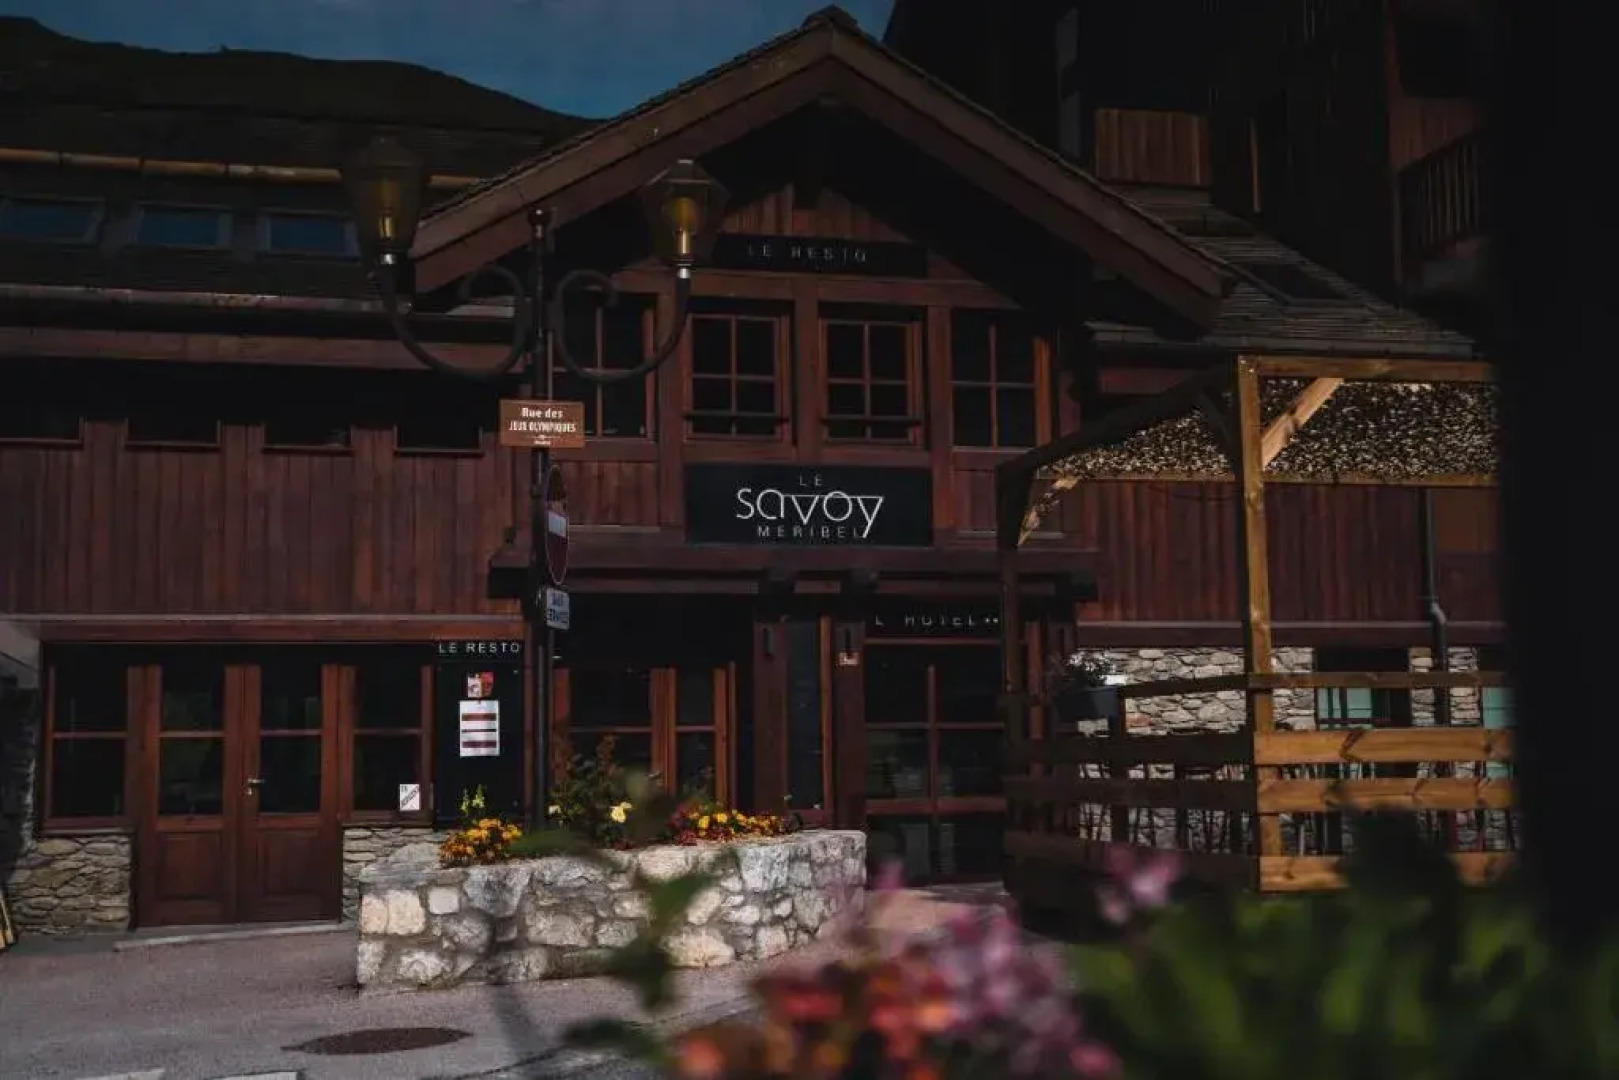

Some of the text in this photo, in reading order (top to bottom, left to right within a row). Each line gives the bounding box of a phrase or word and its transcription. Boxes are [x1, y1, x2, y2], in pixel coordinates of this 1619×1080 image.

[748, 244, 772, 256] LE
[521, 407, 564, 418] Rue des
[508, 420, 577, 433] JEUX OLYMPIQUES
[799, 475, 823, 486] LE
[439, 641, 520, 654] LE RESTO
